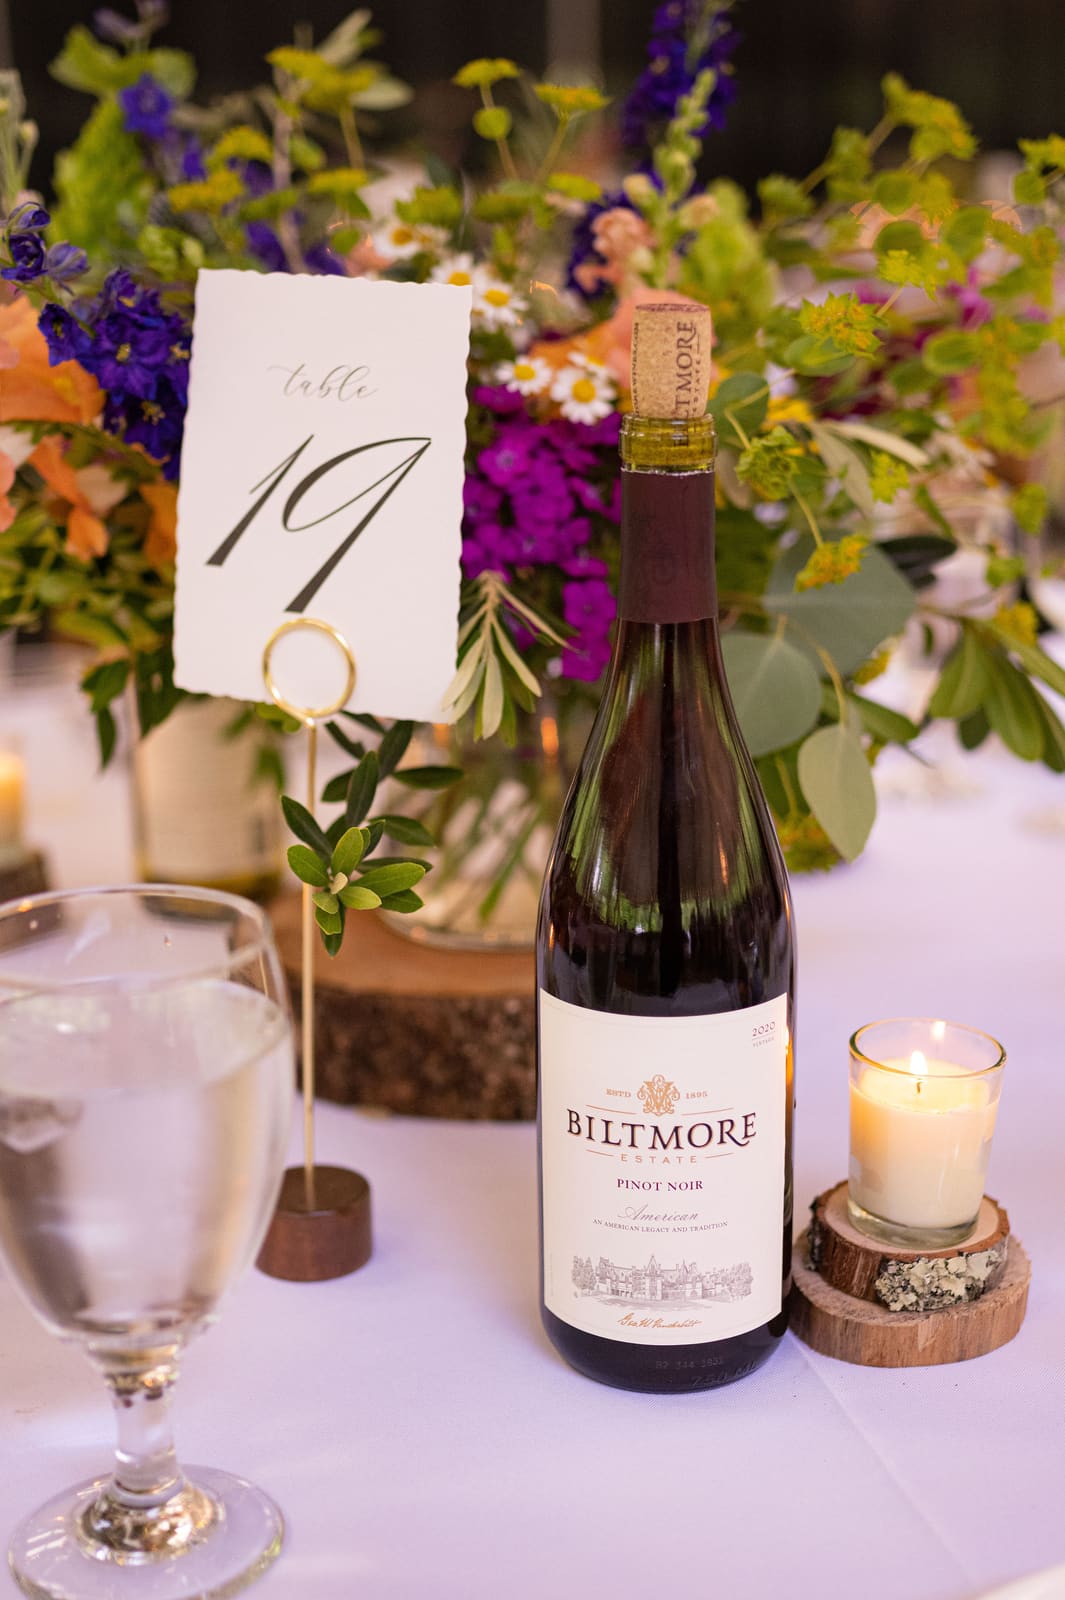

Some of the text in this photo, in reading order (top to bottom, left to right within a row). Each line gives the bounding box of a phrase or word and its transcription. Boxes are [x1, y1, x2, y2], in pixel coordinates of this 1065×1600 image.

[267, 364, 379, 402] table
[205, 434, 432, 614] 19
[752, 1021, 775, 1037] 2020
[685, 1090, 708, 1099] 1895
[567, 1108, 758, 1150] BILTMORE
[620, 1153, 698, 1165] ESTATE
[617, 1178, 704, 1192] PINOT NOIR
[617, 1203, 699, 1222] American
[604, 1221, 640, 1233] AMERICAN
[641, 1225, 670, 1233] LEGACY
[690, 1220, 729, 1232] TRADITION
